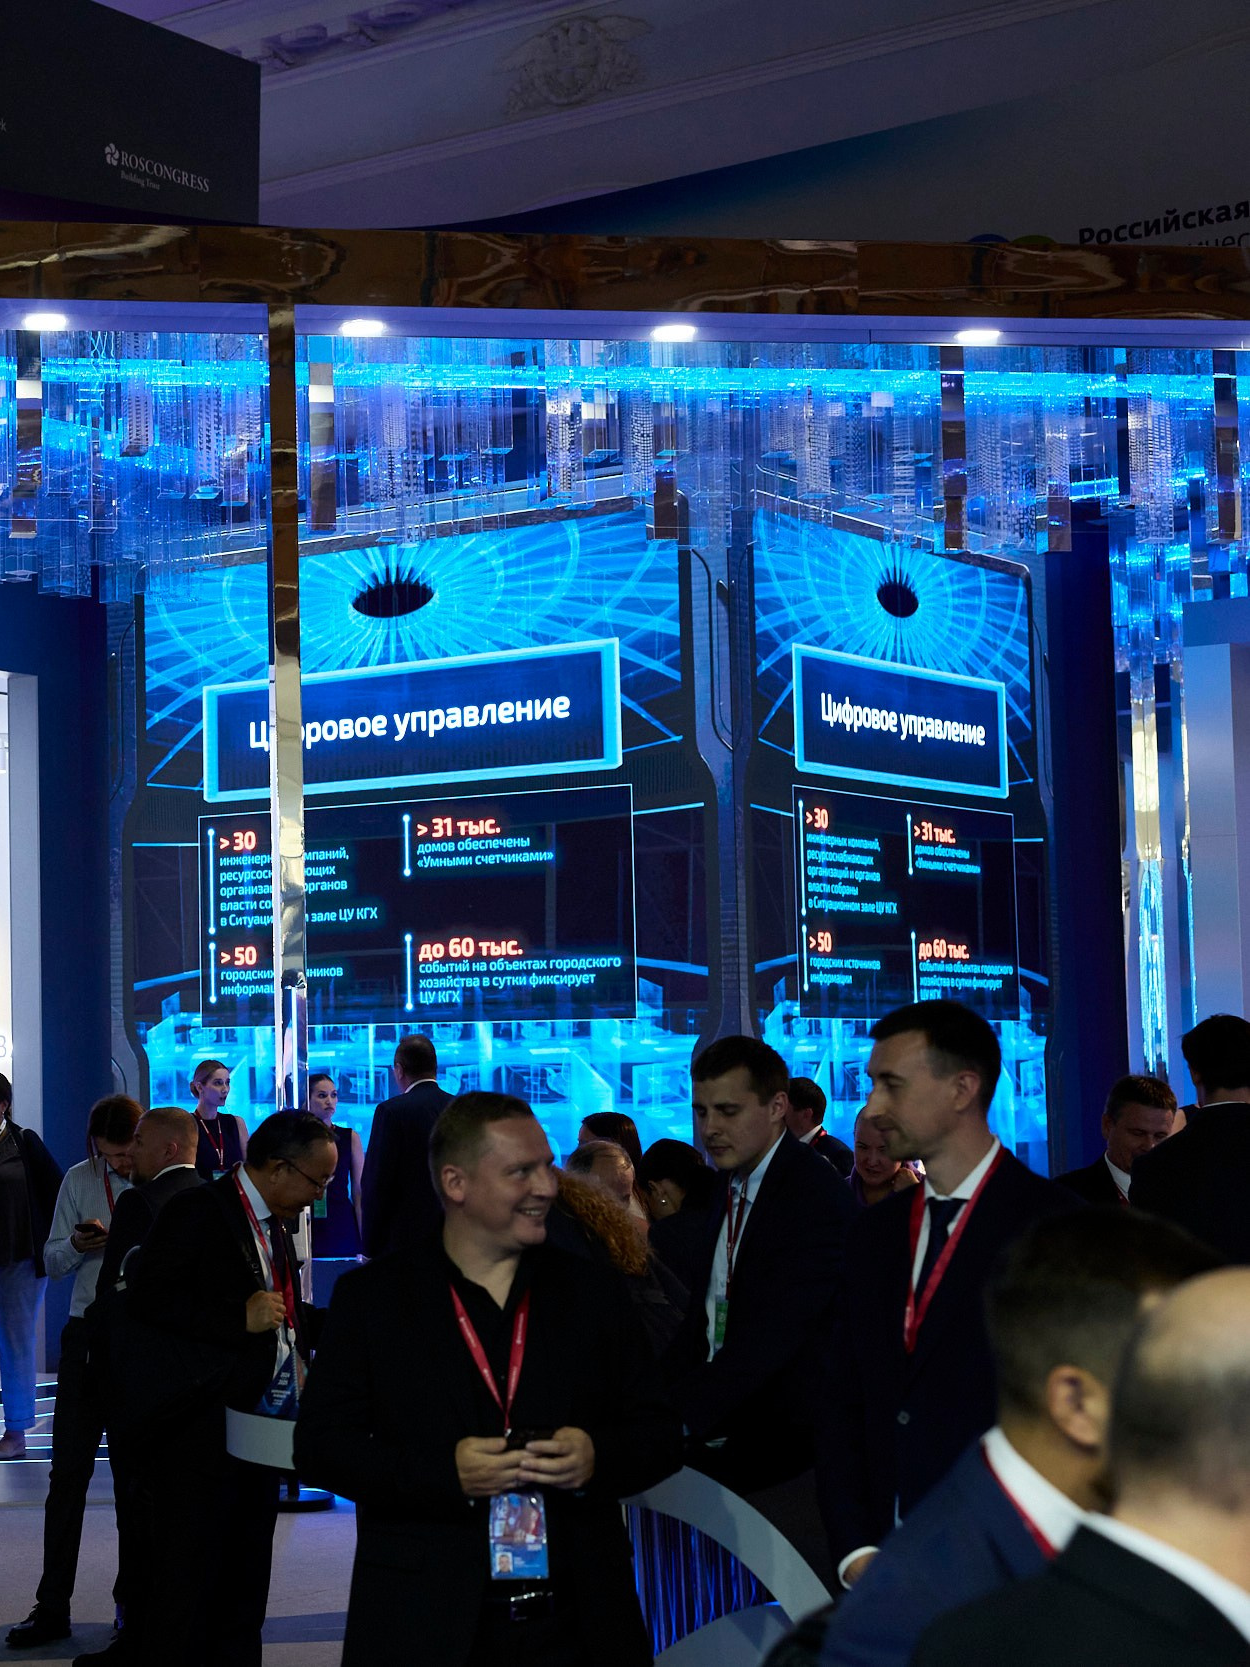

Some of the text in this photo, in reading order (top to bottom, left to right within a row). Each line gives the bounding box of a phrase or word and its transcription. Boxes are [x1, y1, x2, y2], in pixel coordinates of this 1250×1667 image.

[121, 150, 210, 193] ROSCONGRESS
[1079, 200, 1250, 244] Российская
[250, 695, 571, 752] Цровое управление
[821, 692, 986, 746] Цифровое управление
[432, 817, 453, 838] 31
[457, 819, 501, 836] тыс.
[814, 807, 829, 829] 30
[233, 831, 256, 851] 30
[921, 821, 933, 841] 31
[933, 827, 956, 844] тыс.
[304, 847, 349, 861] мпаний,
[417, 837, 530, 855] домов обеспечены
[417, 851, 554, 868] «Умными счетчиками»
[220, 900, 257, 912] власти
[311, 911, 337, 923] зале
[339, 908, 355, 922] ЦУ
[356, 907, 378, 920] КГХ
[419, 937, 523, 962] до 60 тыс.
[817, 931, 832, 952] 50
[919, 938, 970, 960] до 60 тыс.
[234, 946, 257, 966] 50
[419, 956, 621, 973] событий на объектах городского
[419, 973, 596, 989] хозяйства в сутки фиксирует
[420, 990, 460, 1005] ЦУ КГХ
